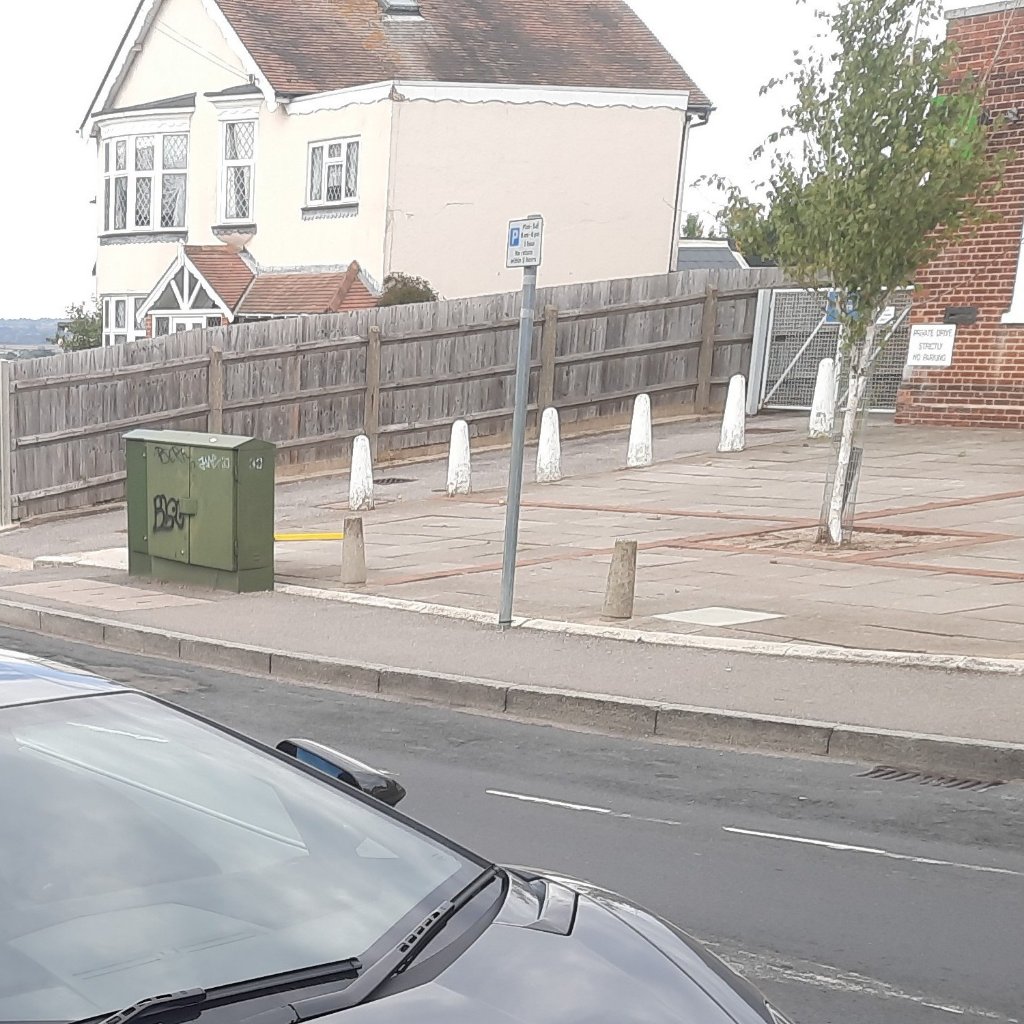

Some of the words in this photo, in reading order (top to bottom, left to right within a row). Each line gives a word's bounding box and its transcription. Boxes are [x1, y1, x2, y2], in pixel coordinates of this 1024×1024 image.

[512, 229, 519, 245] P
[913, 329, 933, 337] PRIVATE
[936, 328, 952, 337] DRIVE
[918, 342, 943, 350] STRICTLY
[912, 353, 920, 361] NO
[922, 353, 946, 362] PARKING
